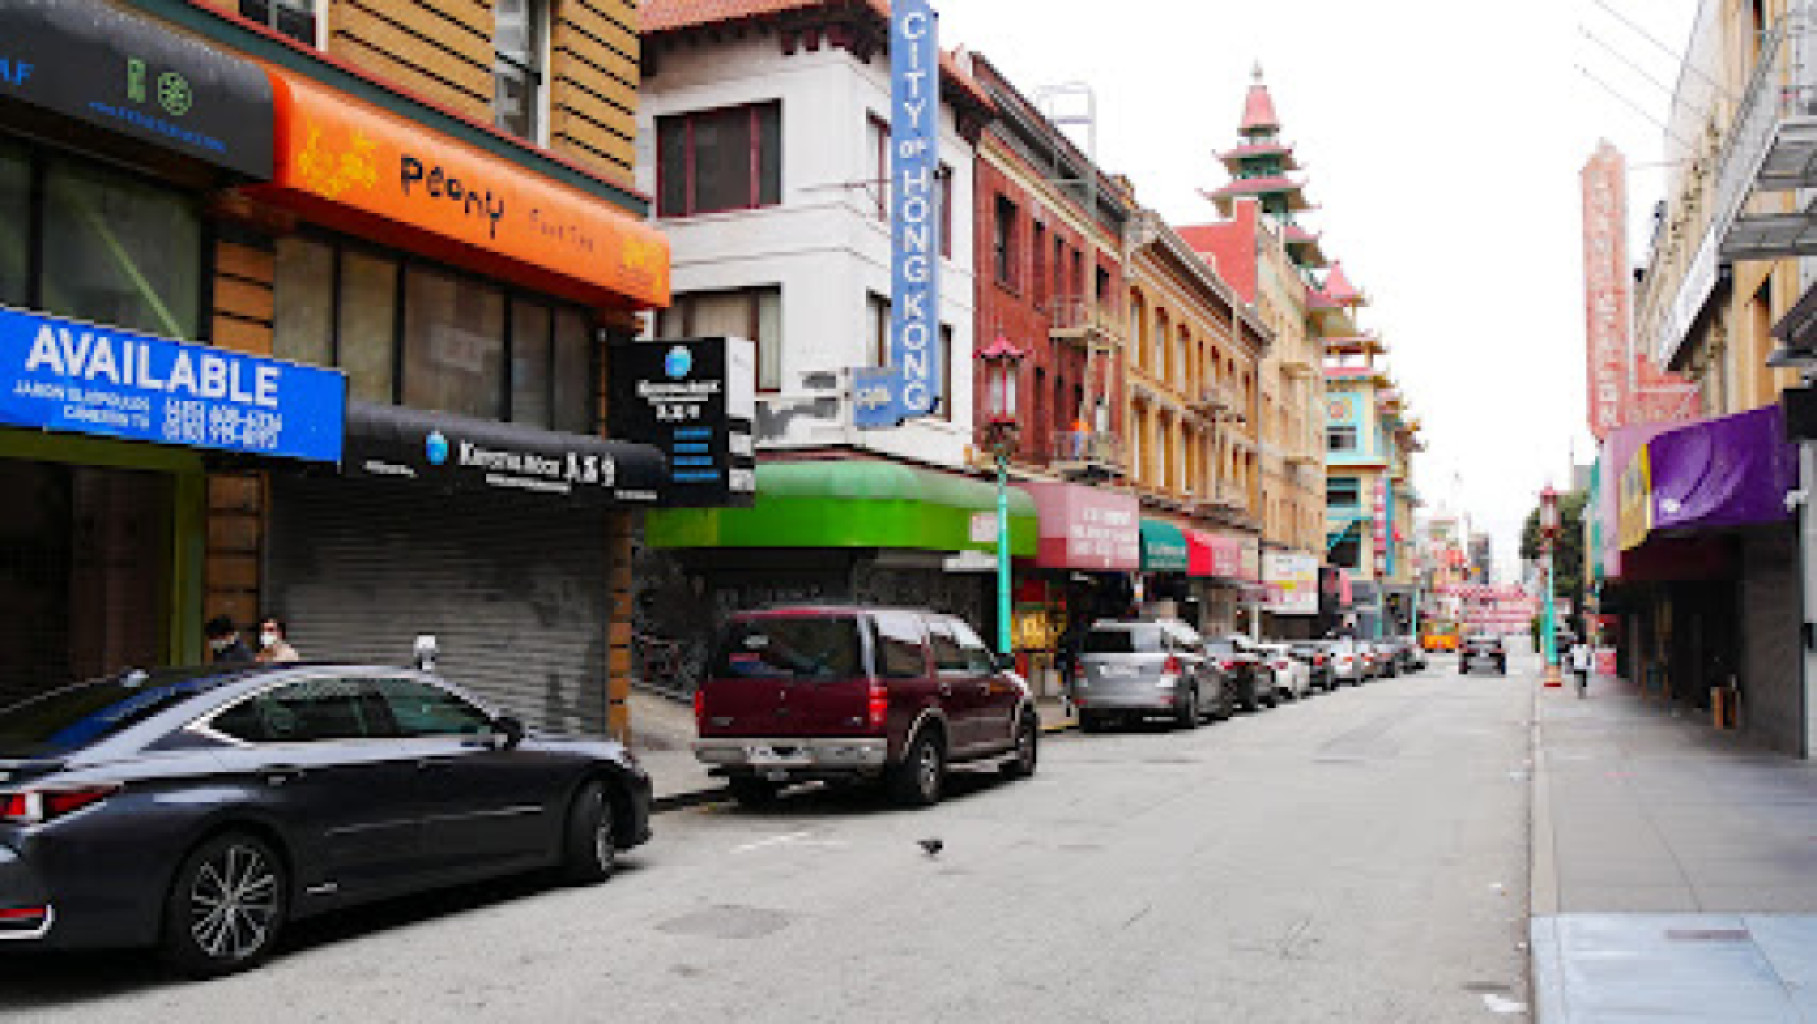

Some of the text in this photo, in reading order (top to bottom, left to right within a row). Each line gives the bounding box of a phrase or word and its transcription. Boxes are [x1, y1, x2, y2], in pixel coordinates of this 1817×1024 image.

[902, 12, 927, 129] CITY
[902, 168, 930, 283] HONG
[25, 323, 278, 406] AVAILABLE
[902, 294, 930, 412] KONG
